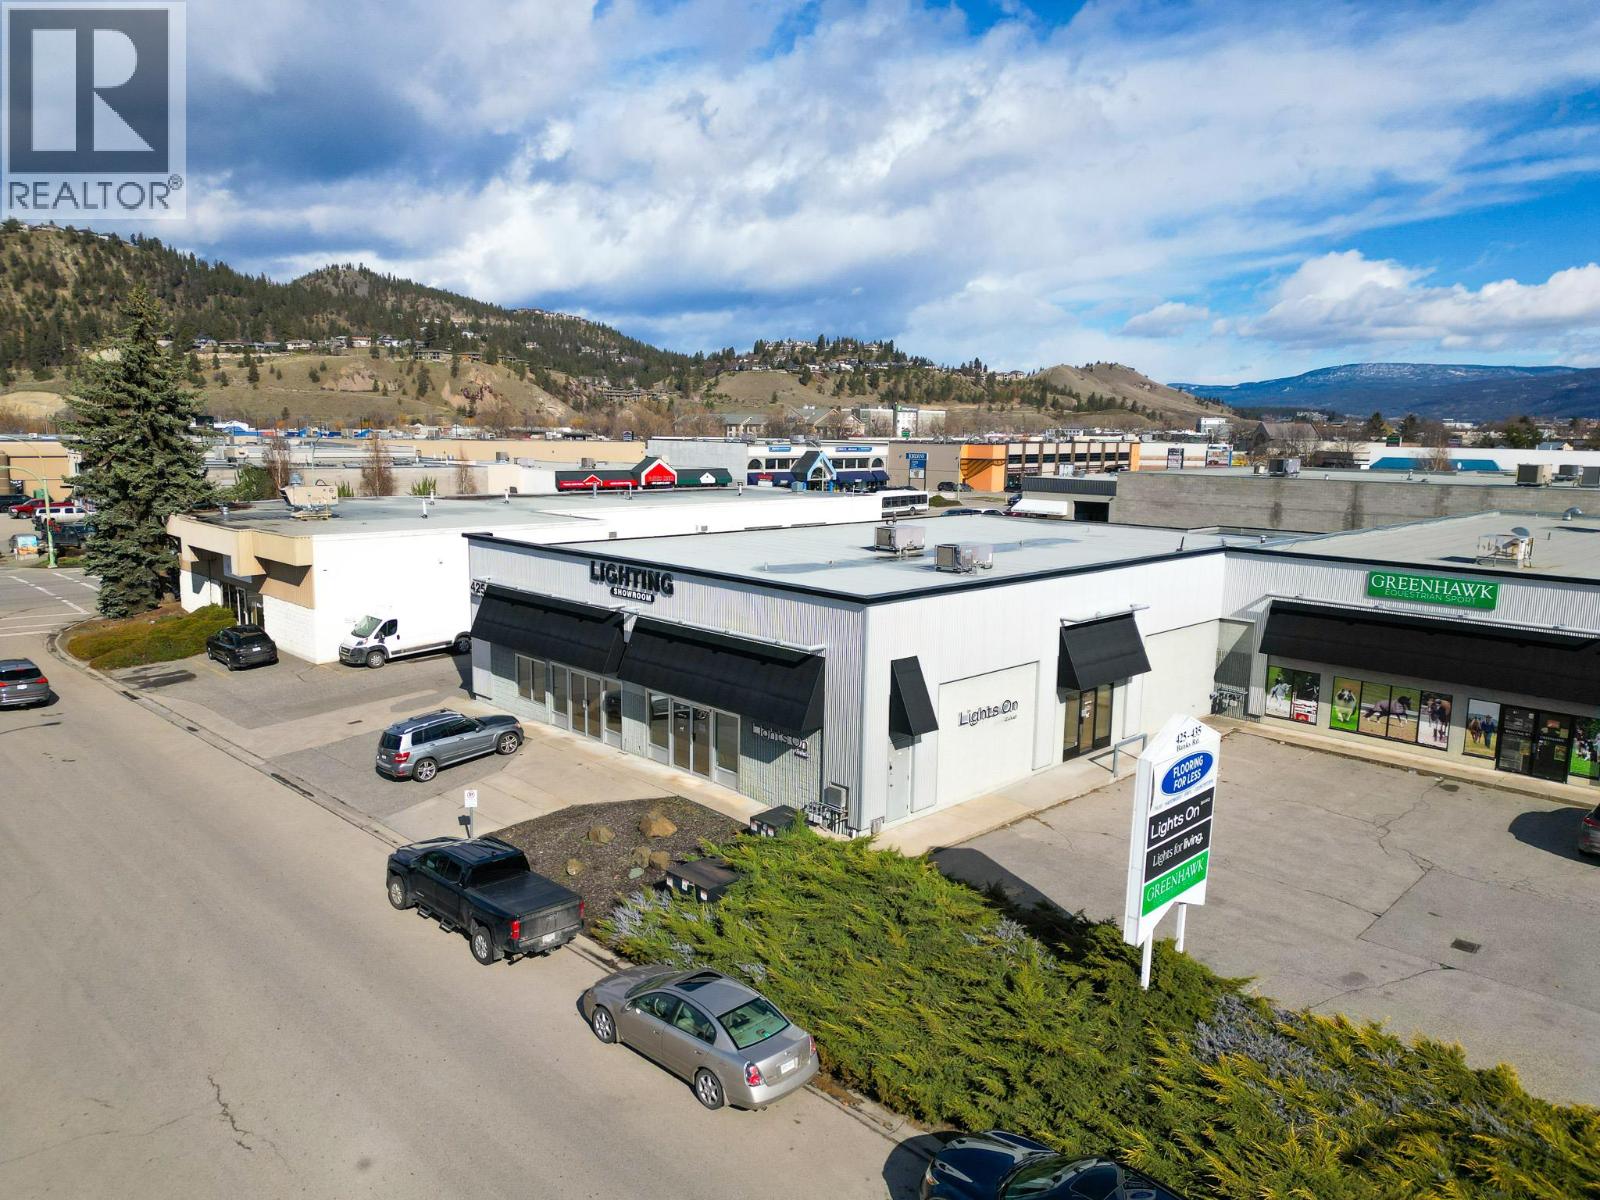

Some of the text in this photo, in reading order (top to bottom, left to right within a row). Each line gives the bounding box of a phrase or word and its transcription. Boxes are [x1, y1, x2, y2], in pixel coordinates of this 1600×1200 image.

[590, 560, 674, 595] LIGHTING
[1371, 574, 1494, 600] GREENHAWK
[613, 587, 652, 602] SHOWROOM
[1384, 588, 1476, 605] EQUESTRIAN SPORT
[958, 699, 1019, 727] Lights On
[1173, 755, 1204, 779] FLOORING
[1173, 775, 1187, 792] FOR
[1187, 768, 1202, 784] LESS
[1150, 805, 1200, 840] Lights On
[1152, 848, 1174, 868] Lights
[1173, 842, 1185, 857] for
[1146, 857, 1205, 902] GREENHAWK
